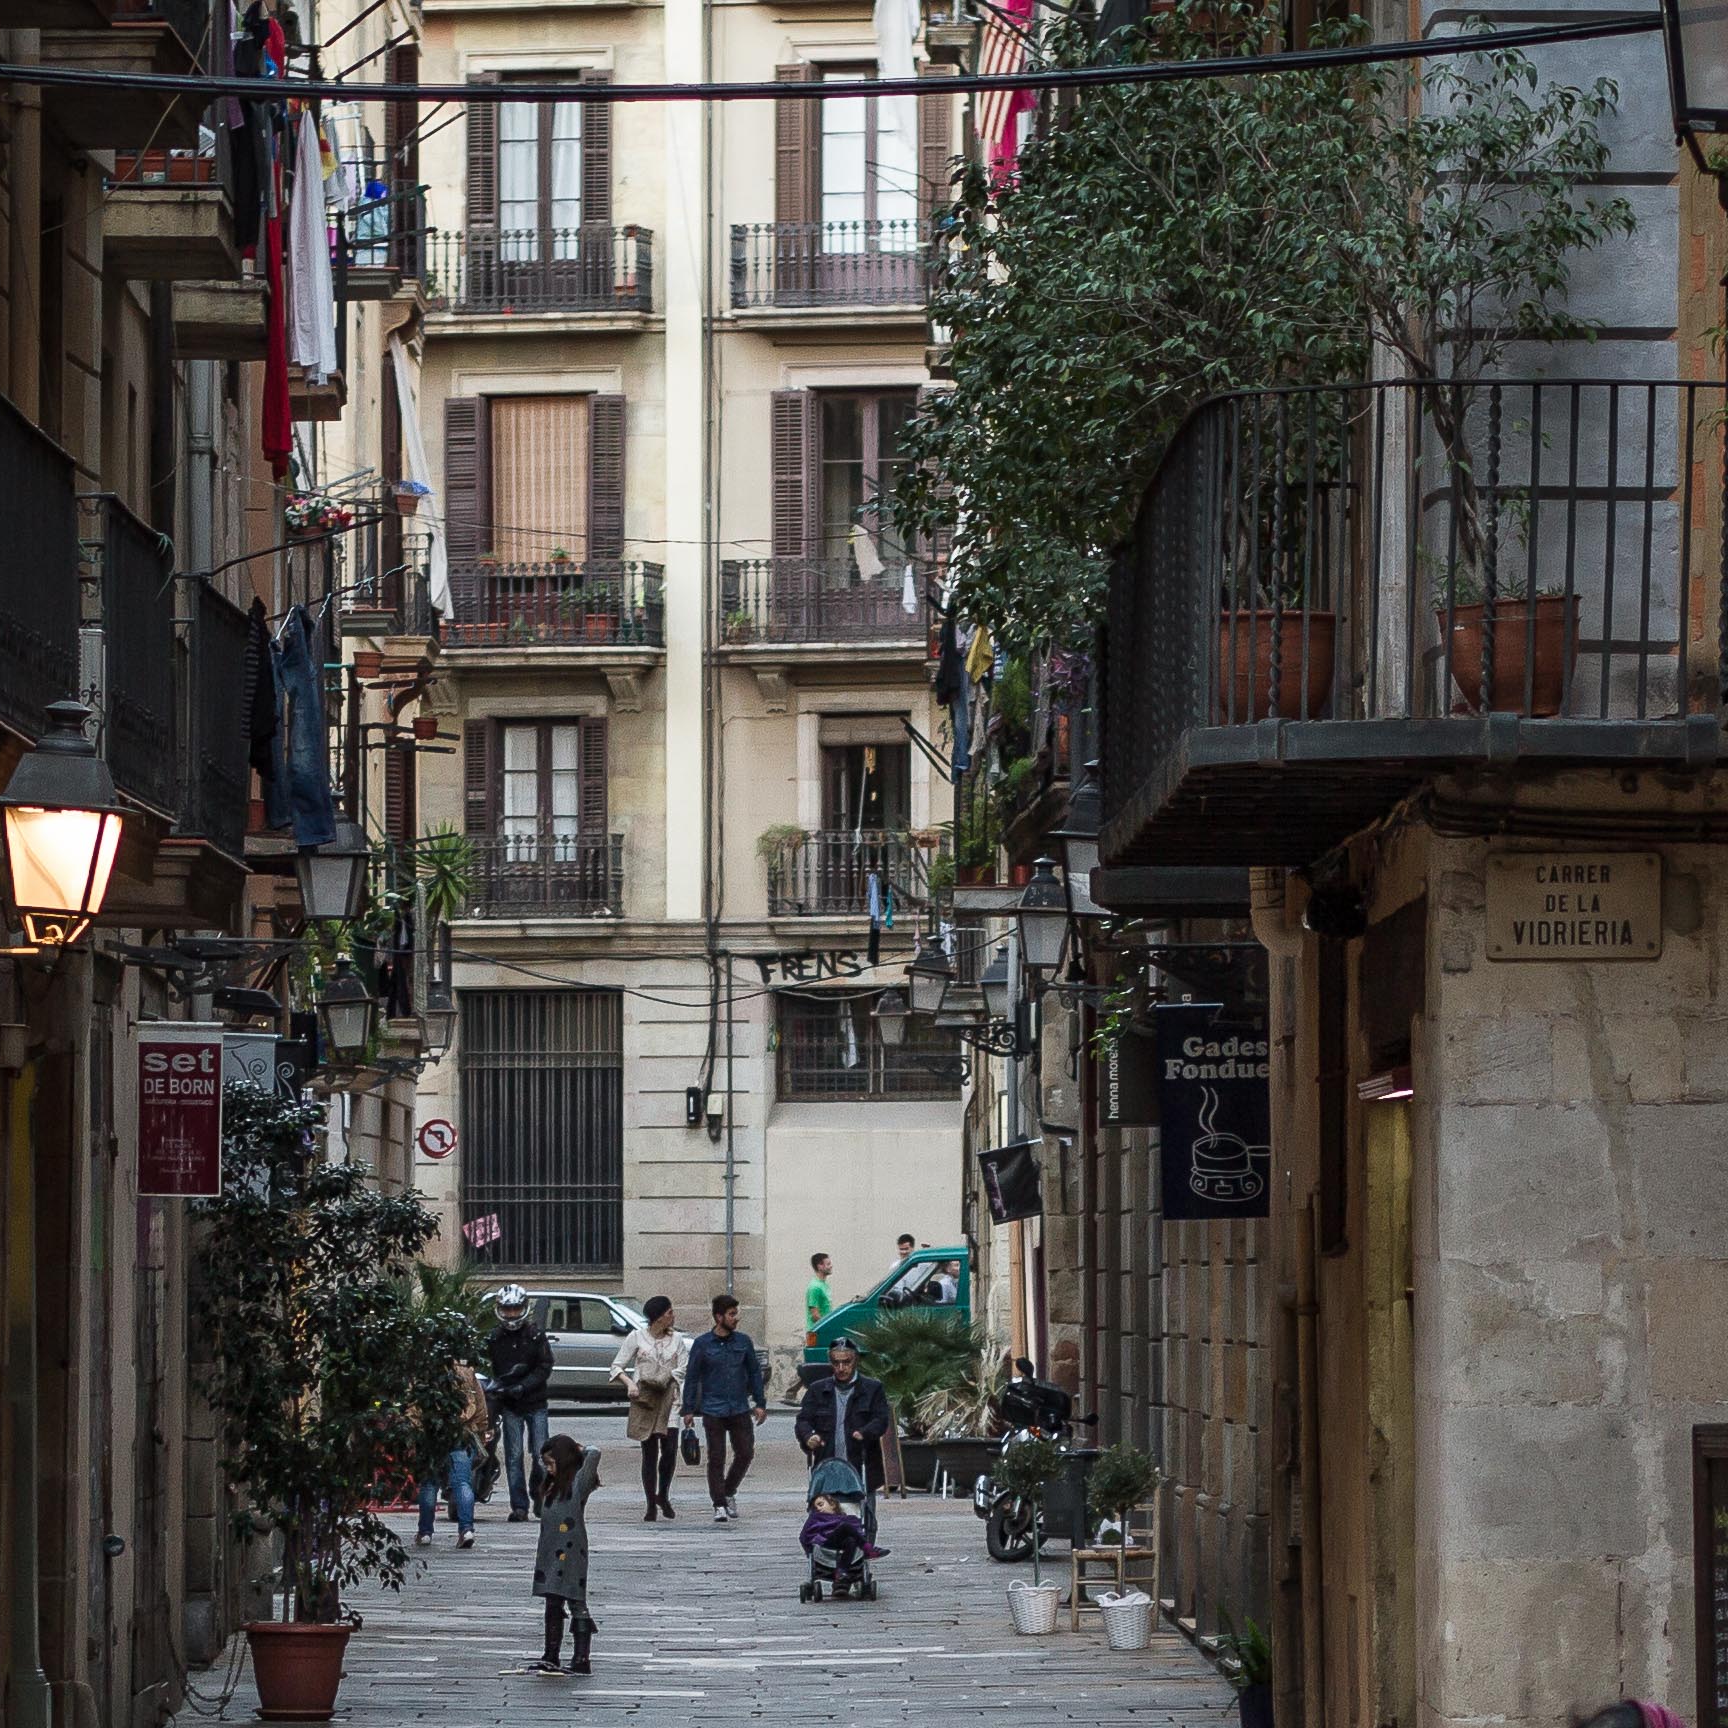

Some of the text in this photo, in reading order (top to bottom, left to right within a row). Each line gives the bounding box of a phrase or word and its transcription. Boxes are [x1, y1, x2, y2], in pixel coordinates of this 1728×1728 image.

[1535, 864, 1611, 884] CARRER
[1545, 894, 1601, 913] DE LA
[1512, 919, 1634, 946] VIDRIERIA
[1182, 1036, 1268, 1058] Gades
[144, 1047, 214, 1073] set
[1164, 1058, 1270, 1081] Fondue
[144, 1078, 215, 1095] DE BORN
[1107, 1082, 1119, 1119] henna
